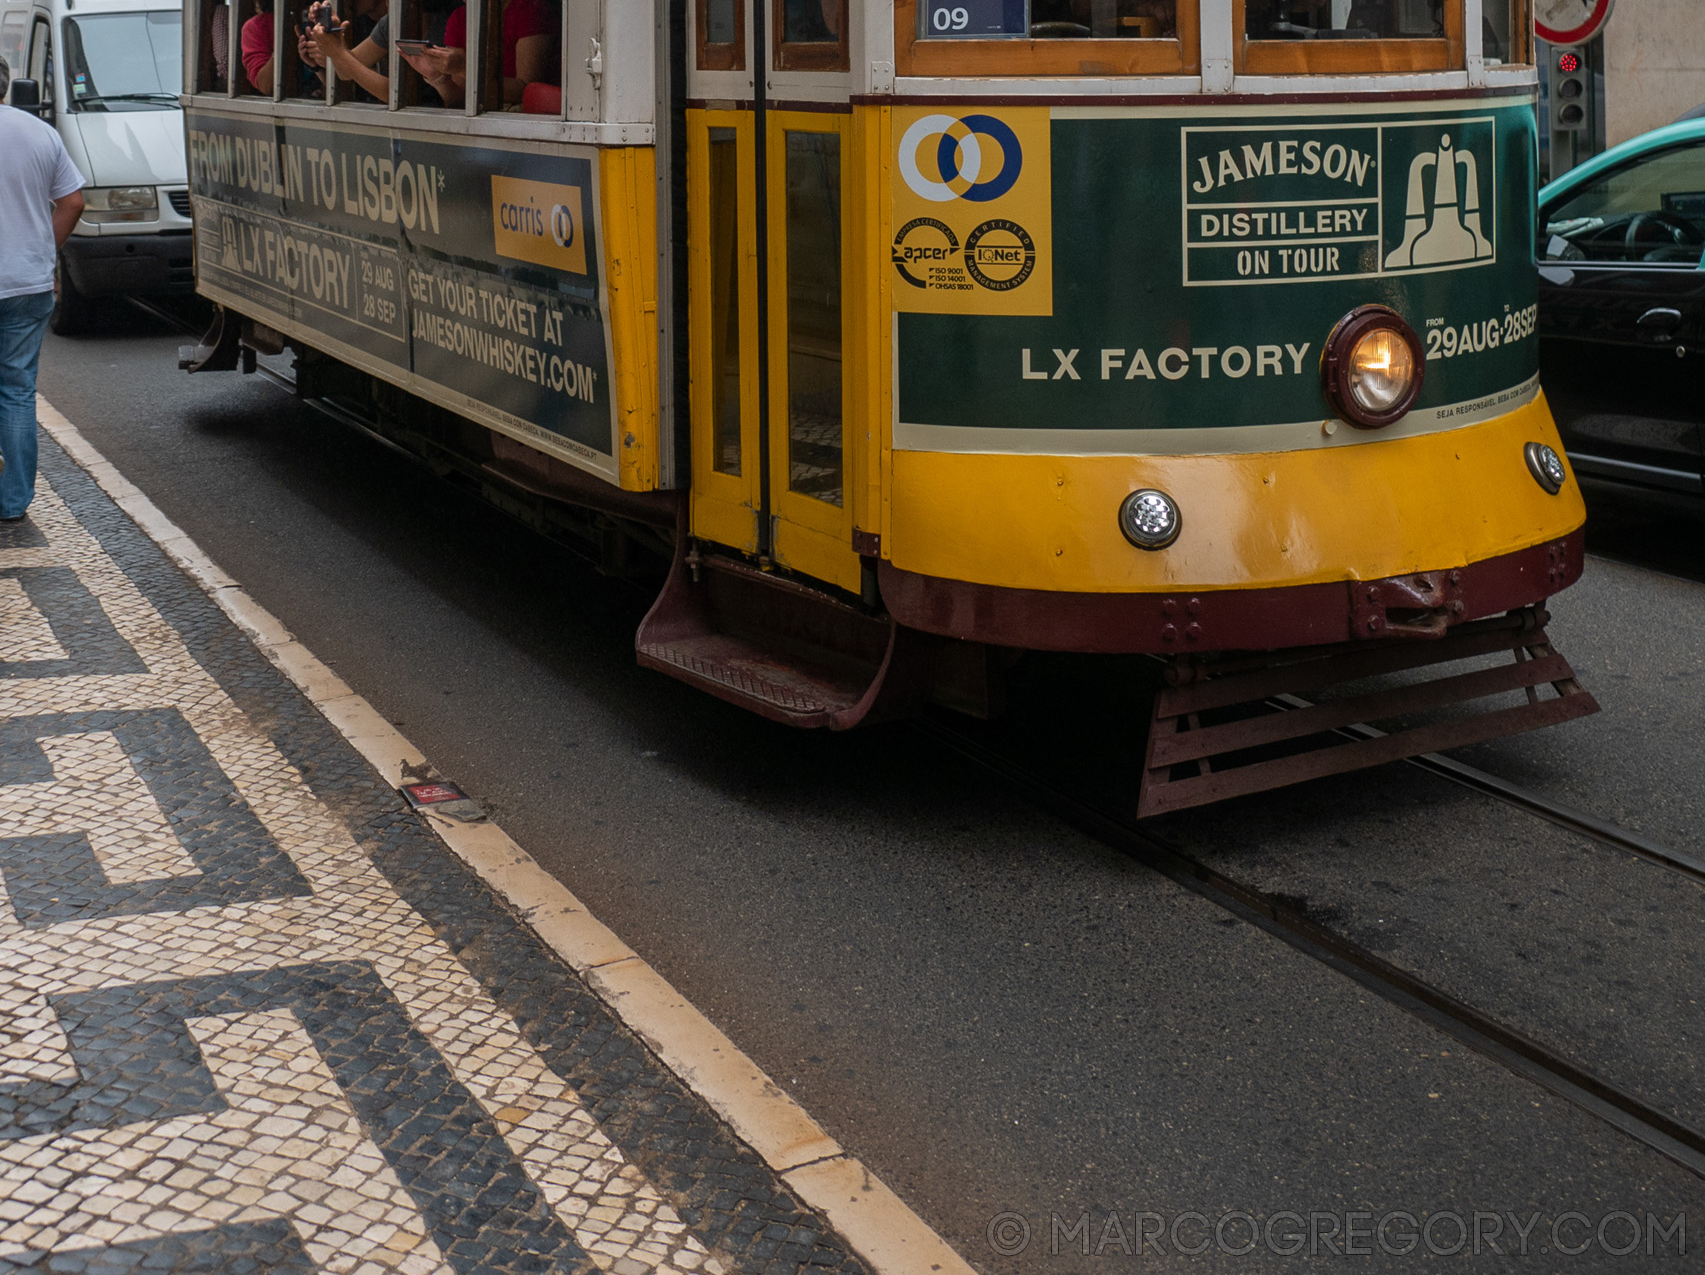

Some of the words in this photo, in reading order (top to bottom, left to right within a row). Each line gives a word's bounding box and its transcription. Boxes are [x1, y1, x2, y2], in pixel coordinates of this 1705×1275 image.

[933, 7, 969, 30] 09
[189, 130, 234, 185] FROM
[235, 136, 304, 202] DUBLIN
[306, 147, 337, 210] TO
[501, 196, 543, 237] carris
[1200, 208, 1368, 237] DISTILLERY
[969, 221, 1030, 245] CERTIFIED
[241, 222, 263, 277] LX
[264, 229, 350, 309] FACTORY
[904, 246, 949, 263] apcer
[978, 248, 1022, 263] IQNet
[1237, 250, 1270, 275] ON
[1278, 247, 1340, 273] TOUR
[361, 259, 373, 285] 29
[375, 265, 395, 292] AUG
[935, 267, 947, 275] ISO
[967, 258, 1012, 290] MANAGEMENT
[1011, 259, 1033, 286] SYSTEM
[363, 293, 375, 318] 28
[377, 297, 396, 325] SEP
[408, 269, 434, 305] GET
[437, 277, 477, 319] YOUR
[479, 289, 537, 338] TICKET
[544, 309, 563, 347] AT
[1426, 317, 1444, 327] FROM
[1021, 348, 1082, 380] LX
[1101, 342, 1311, 380] FACTORY
[1437, 408, 1454, 419] SEJA
